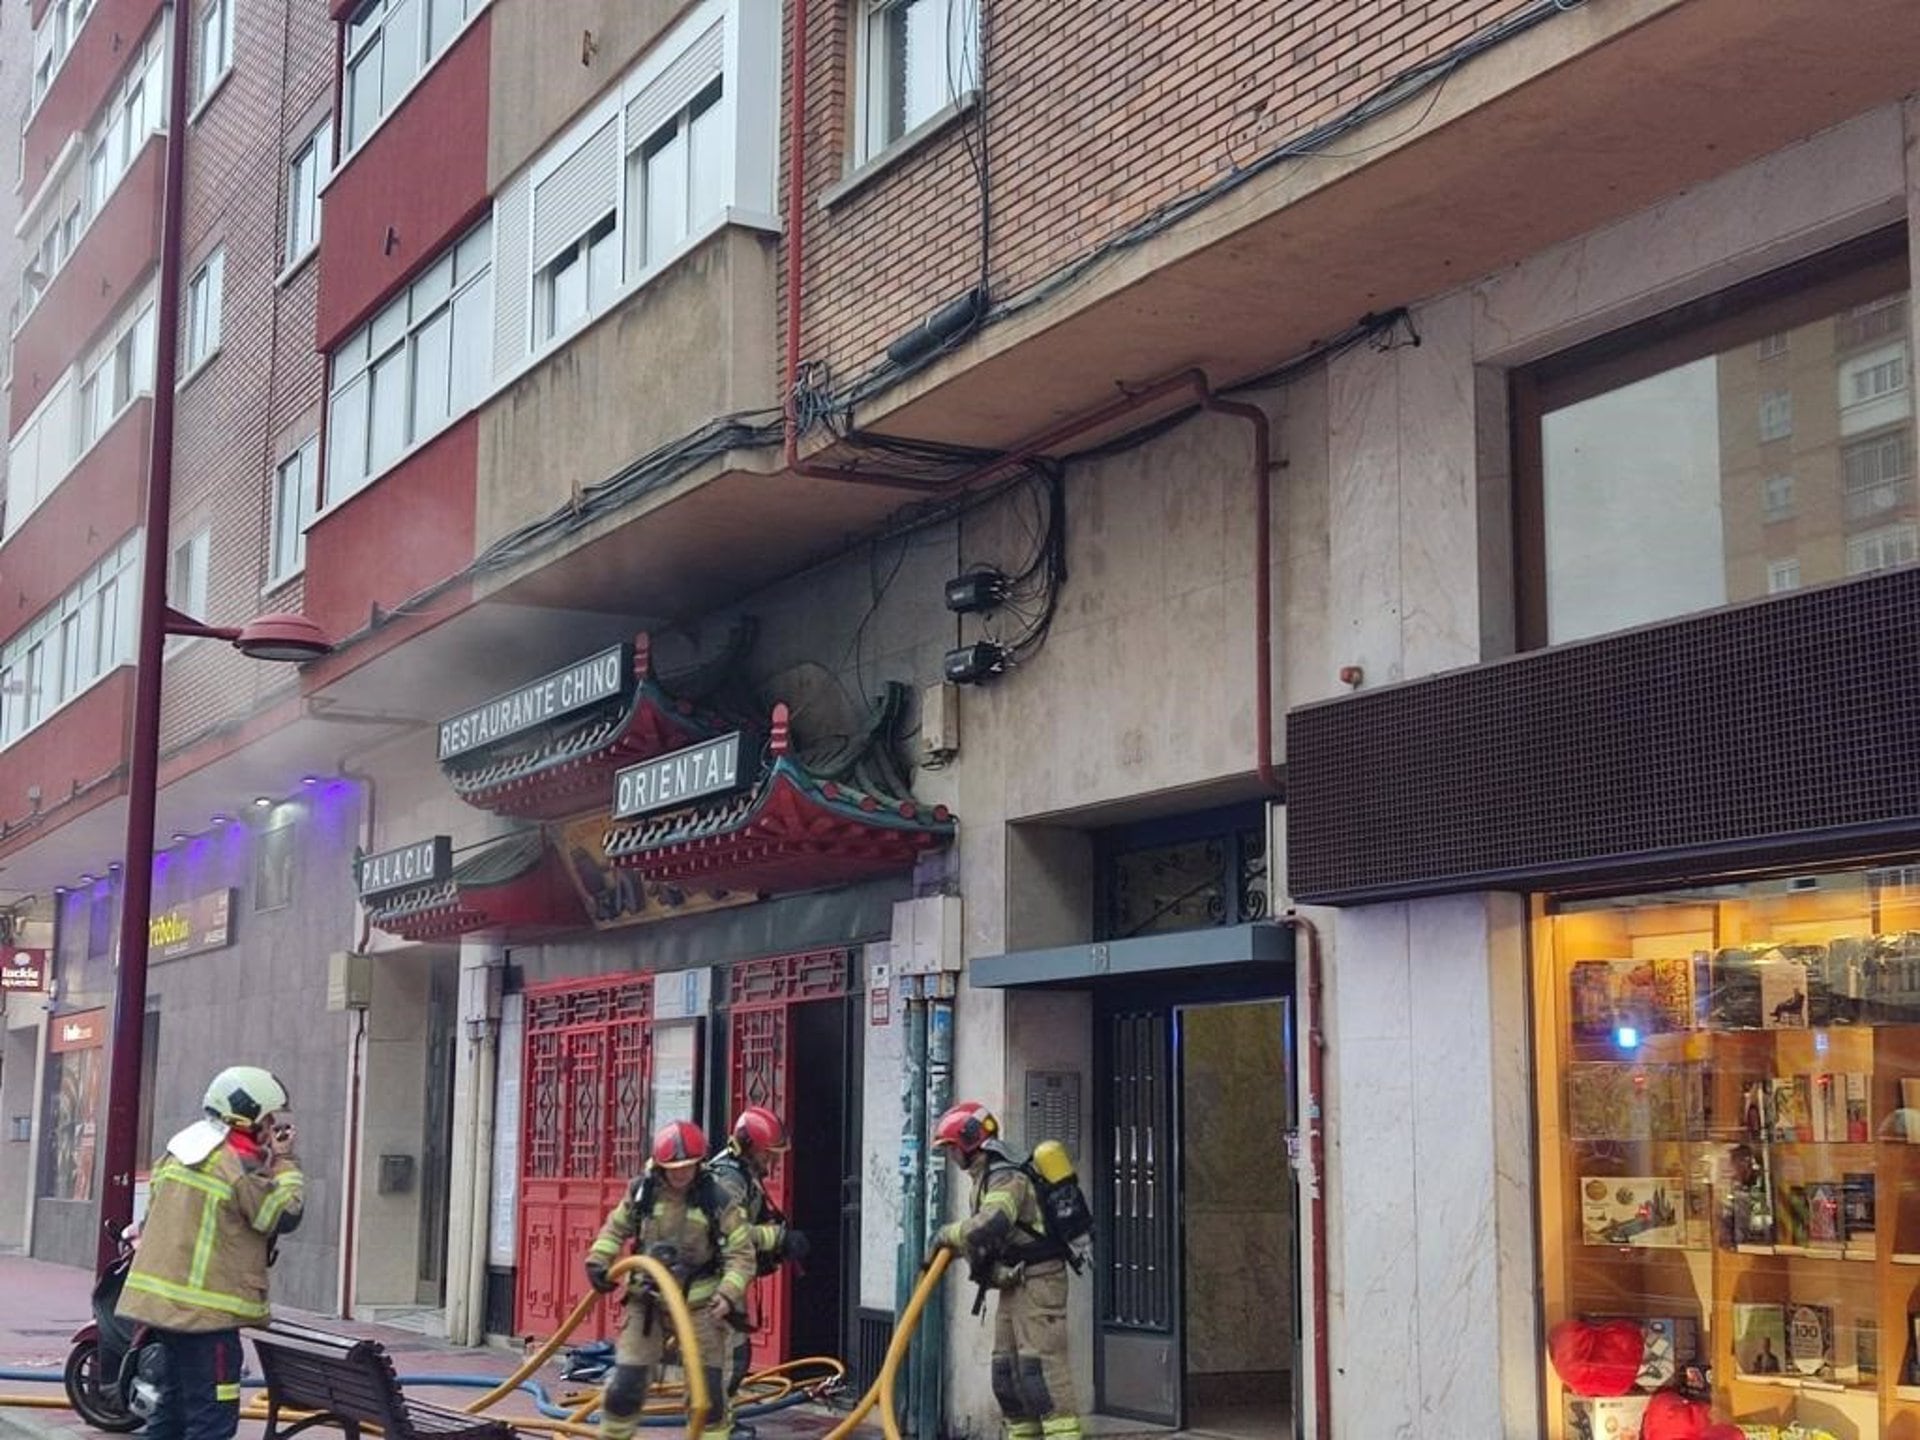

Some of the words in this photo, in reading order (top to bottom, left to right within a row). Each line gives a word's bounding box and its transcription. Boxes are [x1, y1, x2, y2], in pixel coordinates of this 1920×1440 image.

[440, 682, 555, 756] RESTAURANTE
[561, 656, 618, 707] CHINO
[619, 743, 735, 812] ORIENTAL
[362, 845, 433, 890] PALACIO
[1794, 1323, 1819, 1338] 100
